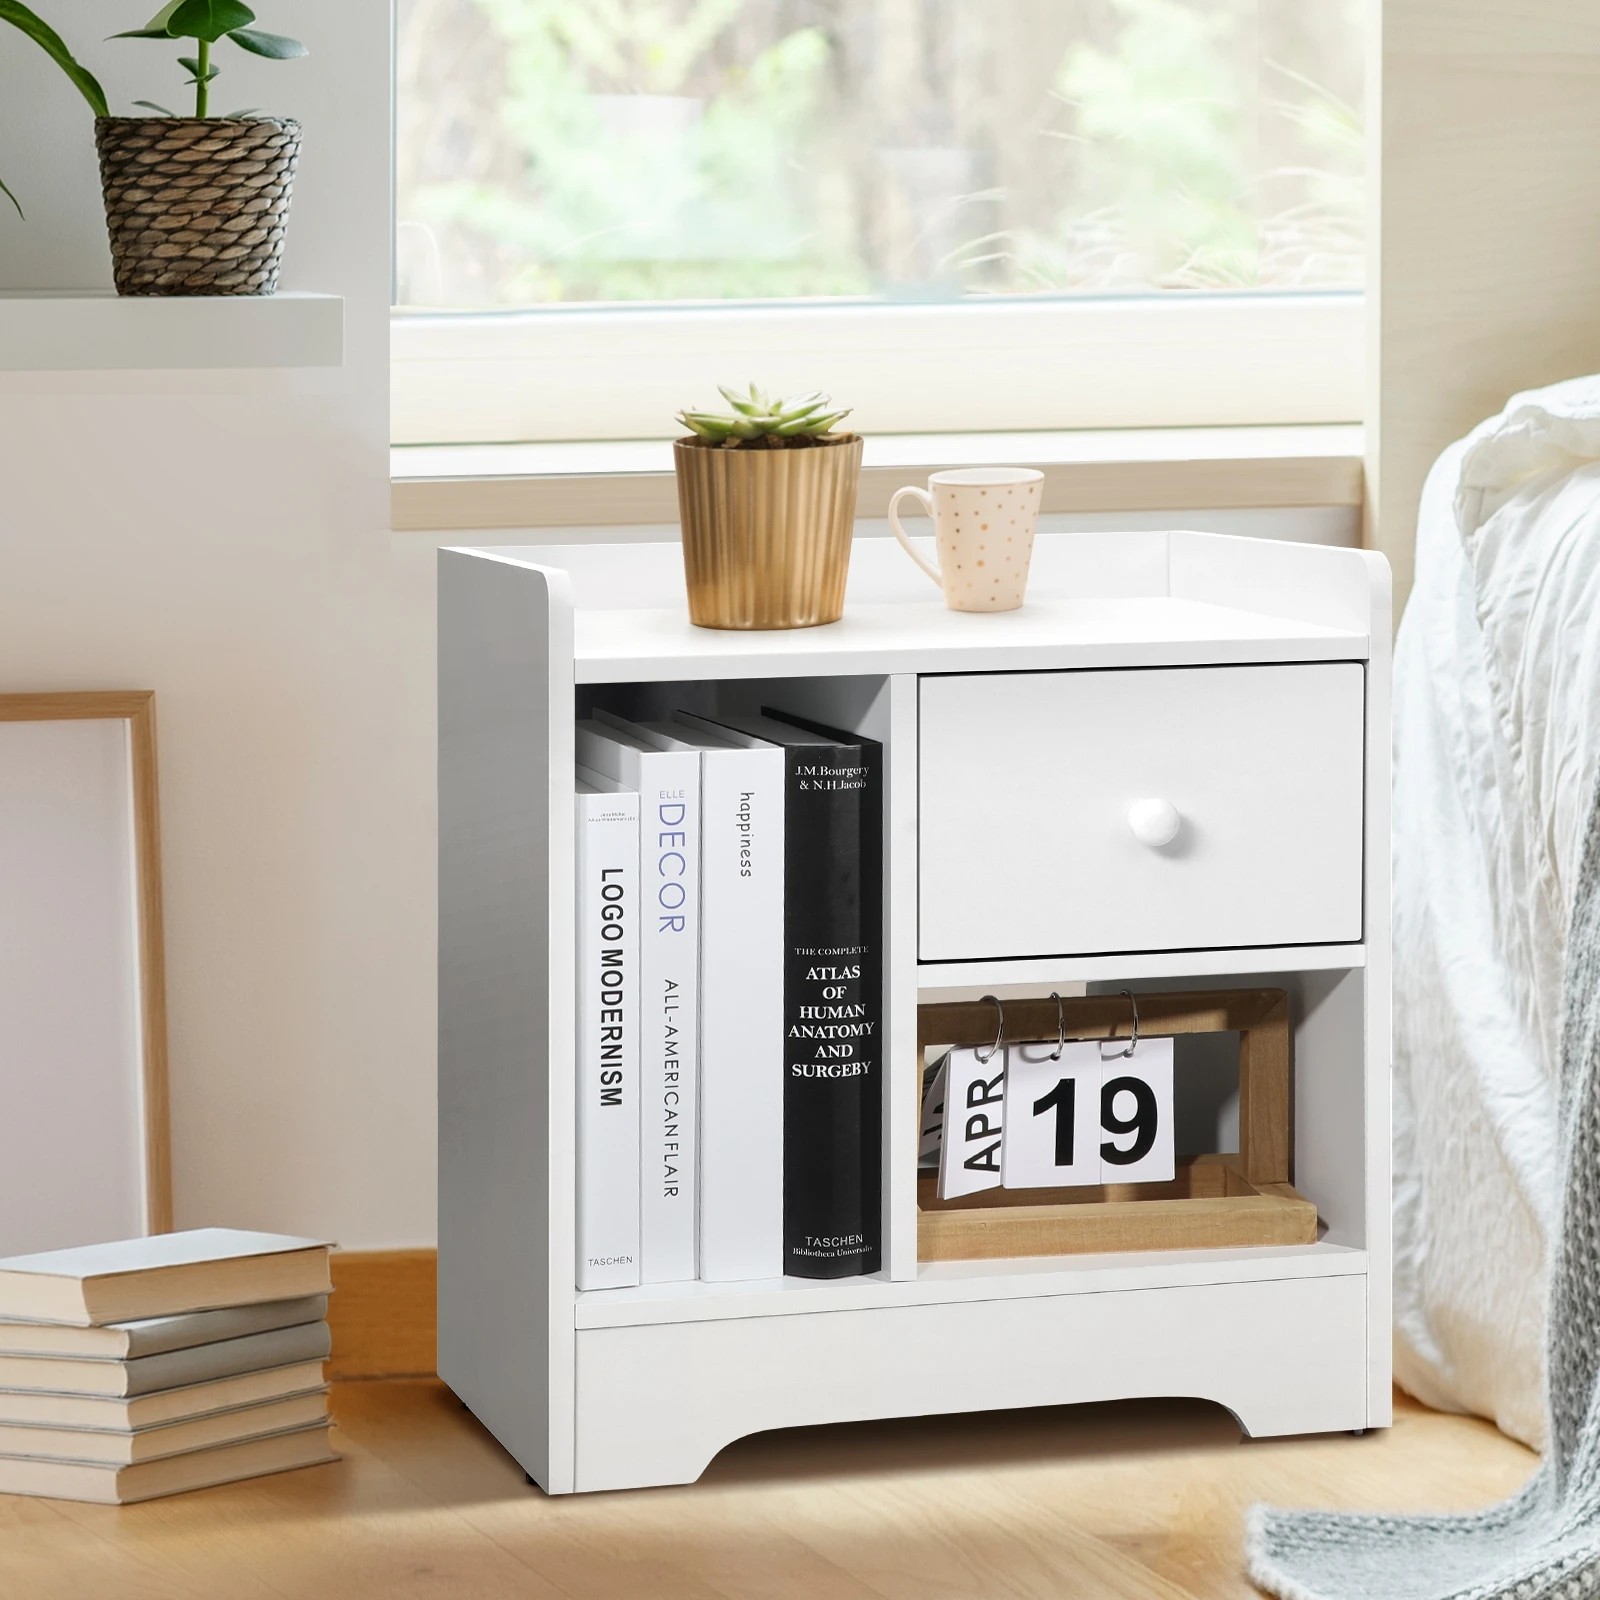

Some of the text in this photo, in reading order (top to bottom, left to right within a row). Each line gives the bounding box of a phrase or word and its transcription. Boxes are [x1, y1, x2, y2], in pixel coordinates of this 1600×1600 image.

[799, 779, 810, 790] &
[659, 790, 685, 800] ELLE
[736, 791, 755, 878] happiness
[659, 803, 686, 933] DECOR
[794, 945, 869, 956] THE COMPLETE
[805, 964, 861, 980] ATLAS
[600, 869, 625, 1107] LOGO MODERNISM
[822, 986, 848, 1000] OF
[799, 1003, 867, 1019] HUMAN
[788, 1021, 875, 1039] ANATOMY
[814, 1044, 854, 1058] AND
[963, 1071, 1004, 1173] APR
[805, 1233, 863, 1248] TASCHEN
[792, 1245, 873, 1258] Bibliotheca Universalis
[588, 1256, 633, 1267] TASCHEN
